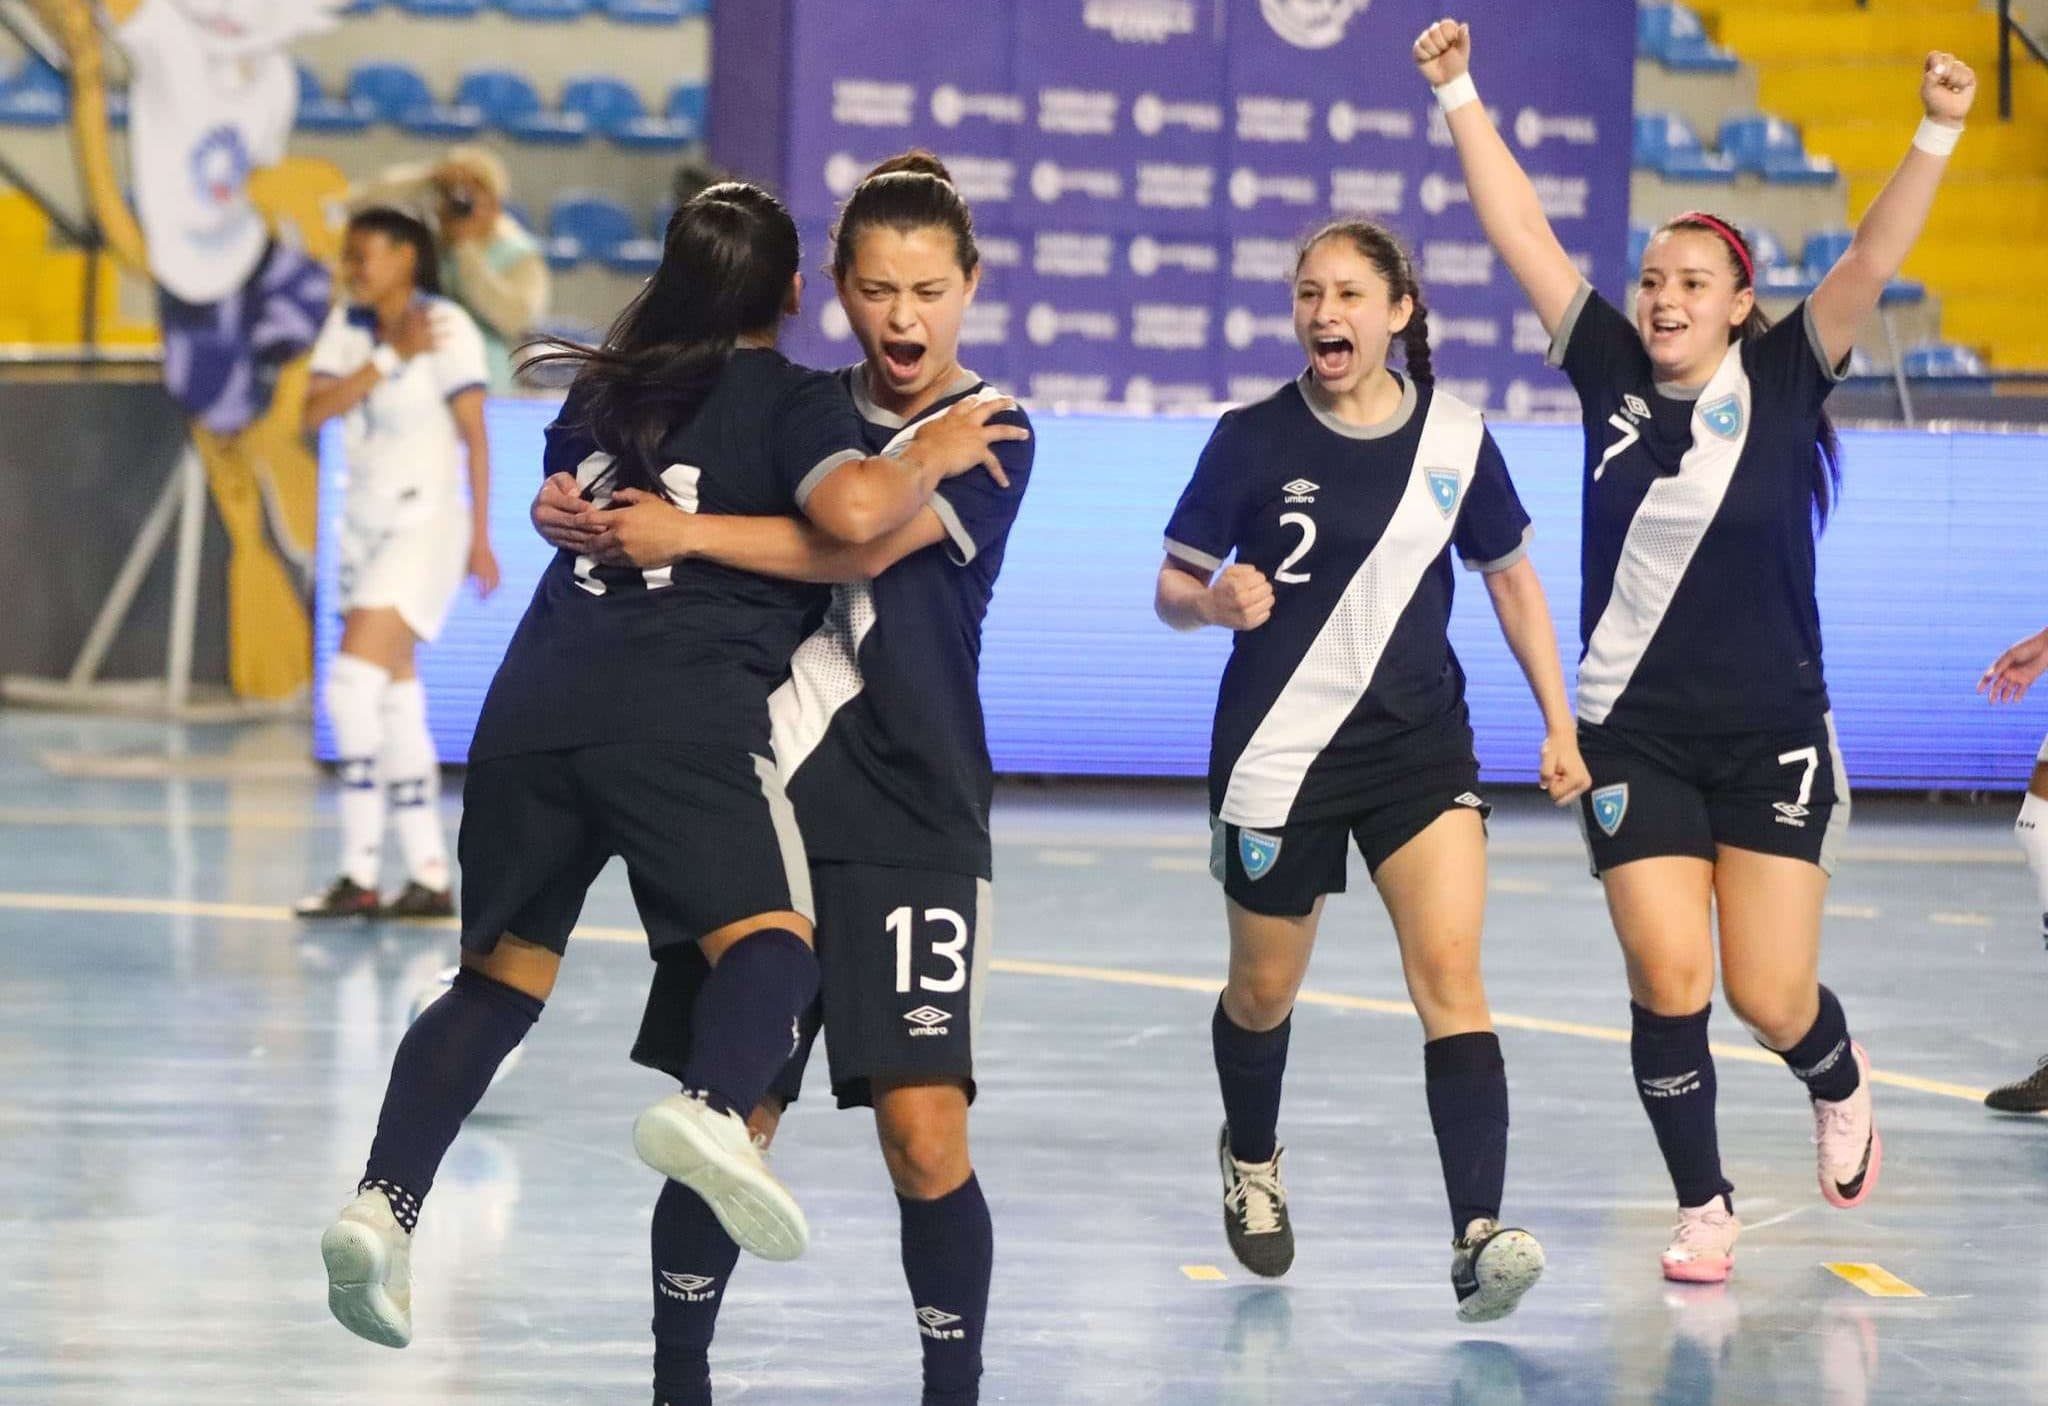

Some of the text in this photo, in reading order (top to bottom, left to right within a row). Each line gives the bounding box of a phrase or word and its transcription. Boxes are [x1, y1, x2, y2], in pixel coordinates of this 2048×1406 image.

[1594, 413, 1640, 482] 7
[1284, 495, 1315, 504] umbro
[1274, 511, 1317, 584] 2
[1777, 745, 1819, 806] 7
[885, 906, 968, 993] 13
[908, 1026, 948, 1036] umbro
[660, 1283, 716, 1302] umbro
